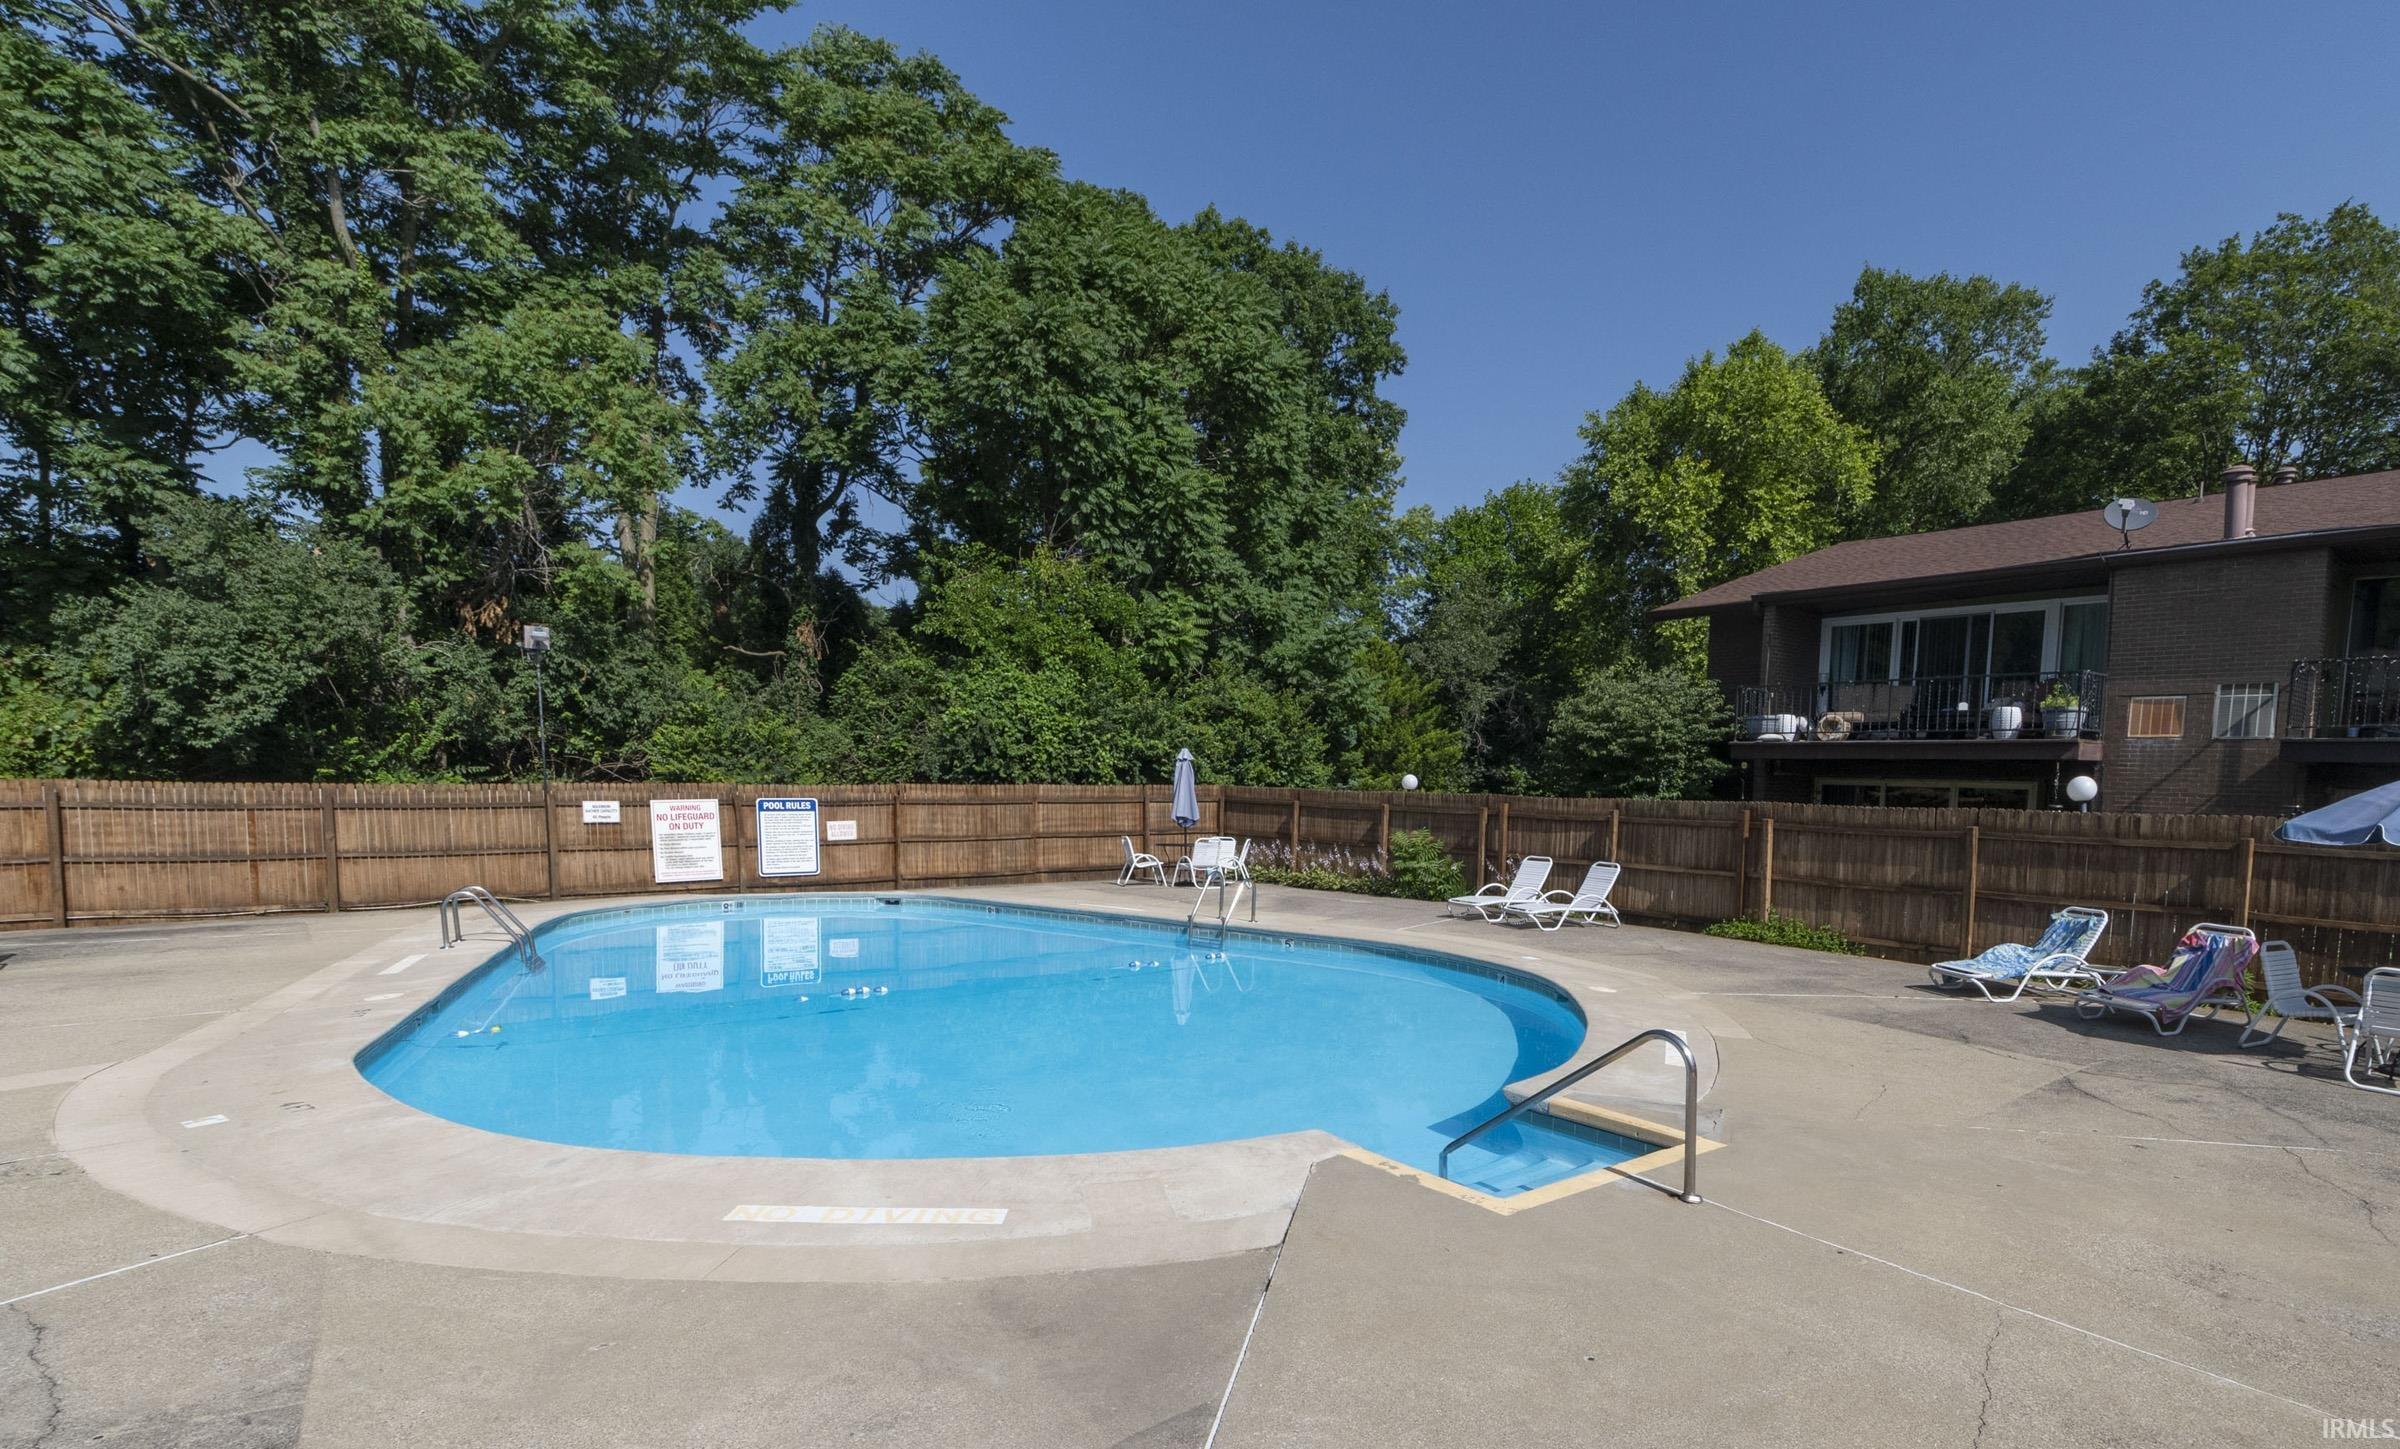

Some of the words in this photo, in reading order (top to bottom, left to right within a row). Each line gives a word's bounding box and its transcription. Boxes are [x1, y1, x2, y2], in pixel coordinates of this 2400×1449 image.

[763, 801, 785, 810] POOL
[786, 801, 811, 810] RULES
[656, 813, 668, 822] NO
[670, 812, 715, 821] LIFEGUARD
[668, 822, 681, 831] ON
[683, 822, 704, 830] DUTY
[731, 1206, 797, 1221] NO
[819, 1207, 999, 1224] DIVING
